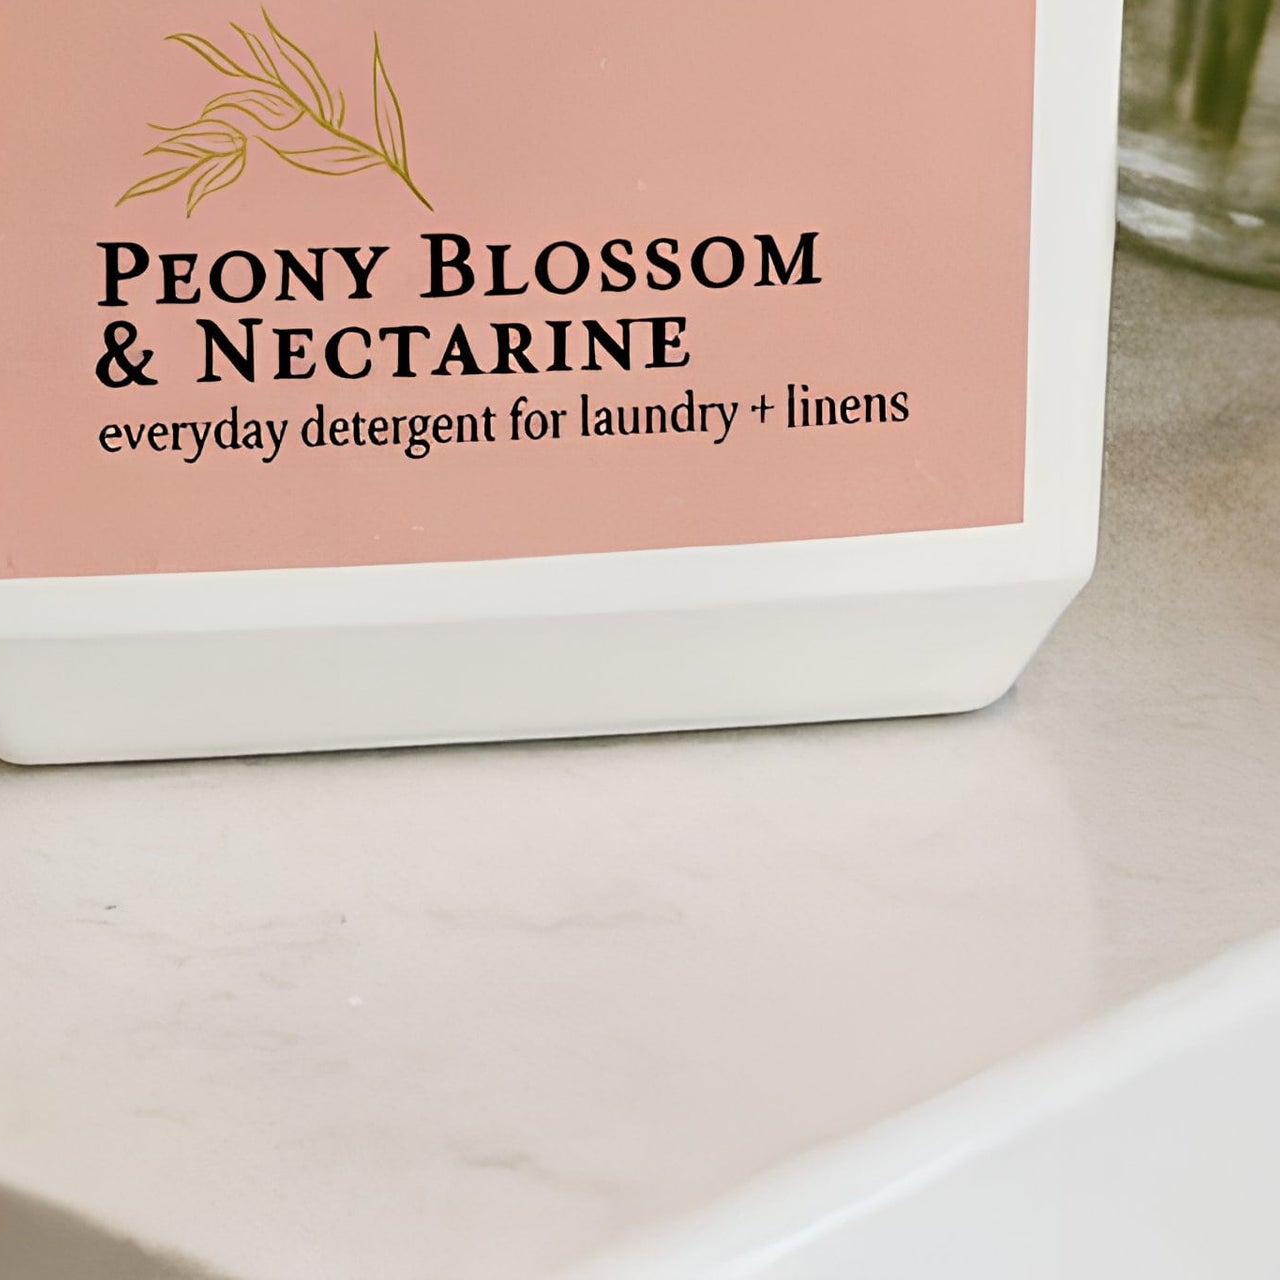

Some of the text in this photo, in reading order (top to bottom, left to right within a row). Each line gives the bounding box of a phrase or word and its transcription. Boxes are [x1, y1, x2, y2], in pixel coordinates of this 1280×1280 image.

[95, 231, 823, 307] PEONY BLOSSOM
[95, 316, 691, 389] & NECTARINE
[98, 383, 910, 465] everyday detergent for laundry + linens
